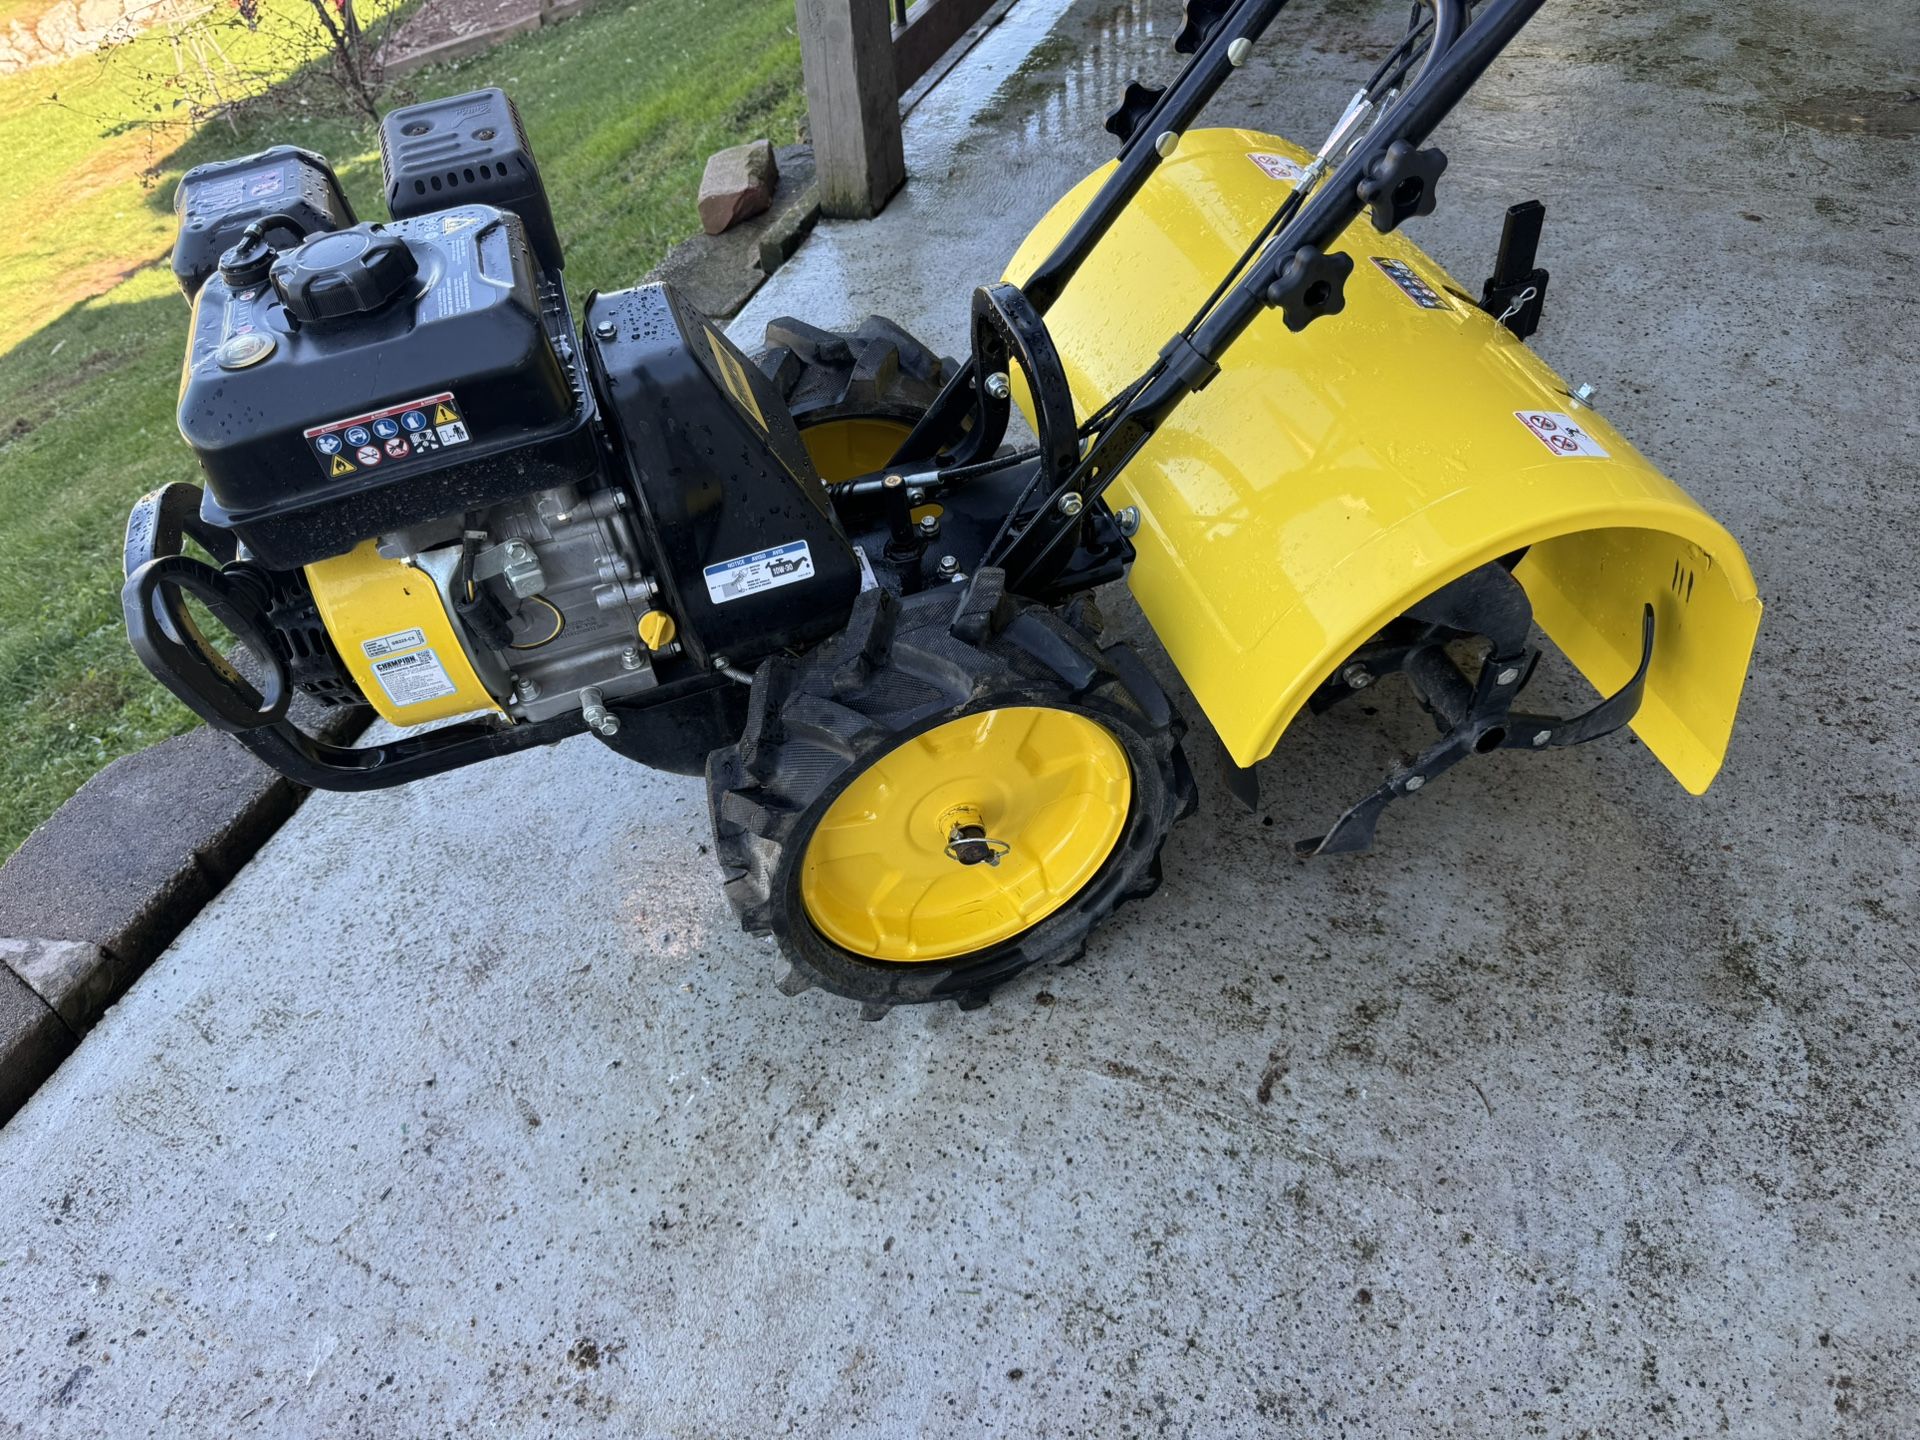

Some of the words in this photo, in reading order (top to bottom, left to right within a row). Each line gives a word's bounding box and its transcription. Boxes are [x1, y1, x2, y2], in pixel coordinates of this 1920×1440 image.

[727, 559, 745, 569] NOTICE
[751, 552, 767, 562] AVISO
[772, 548, 784, 556] AVIS
[772, 563, 794, 575] 10W-30
[376, 655, 416, 670] CHAMPION
